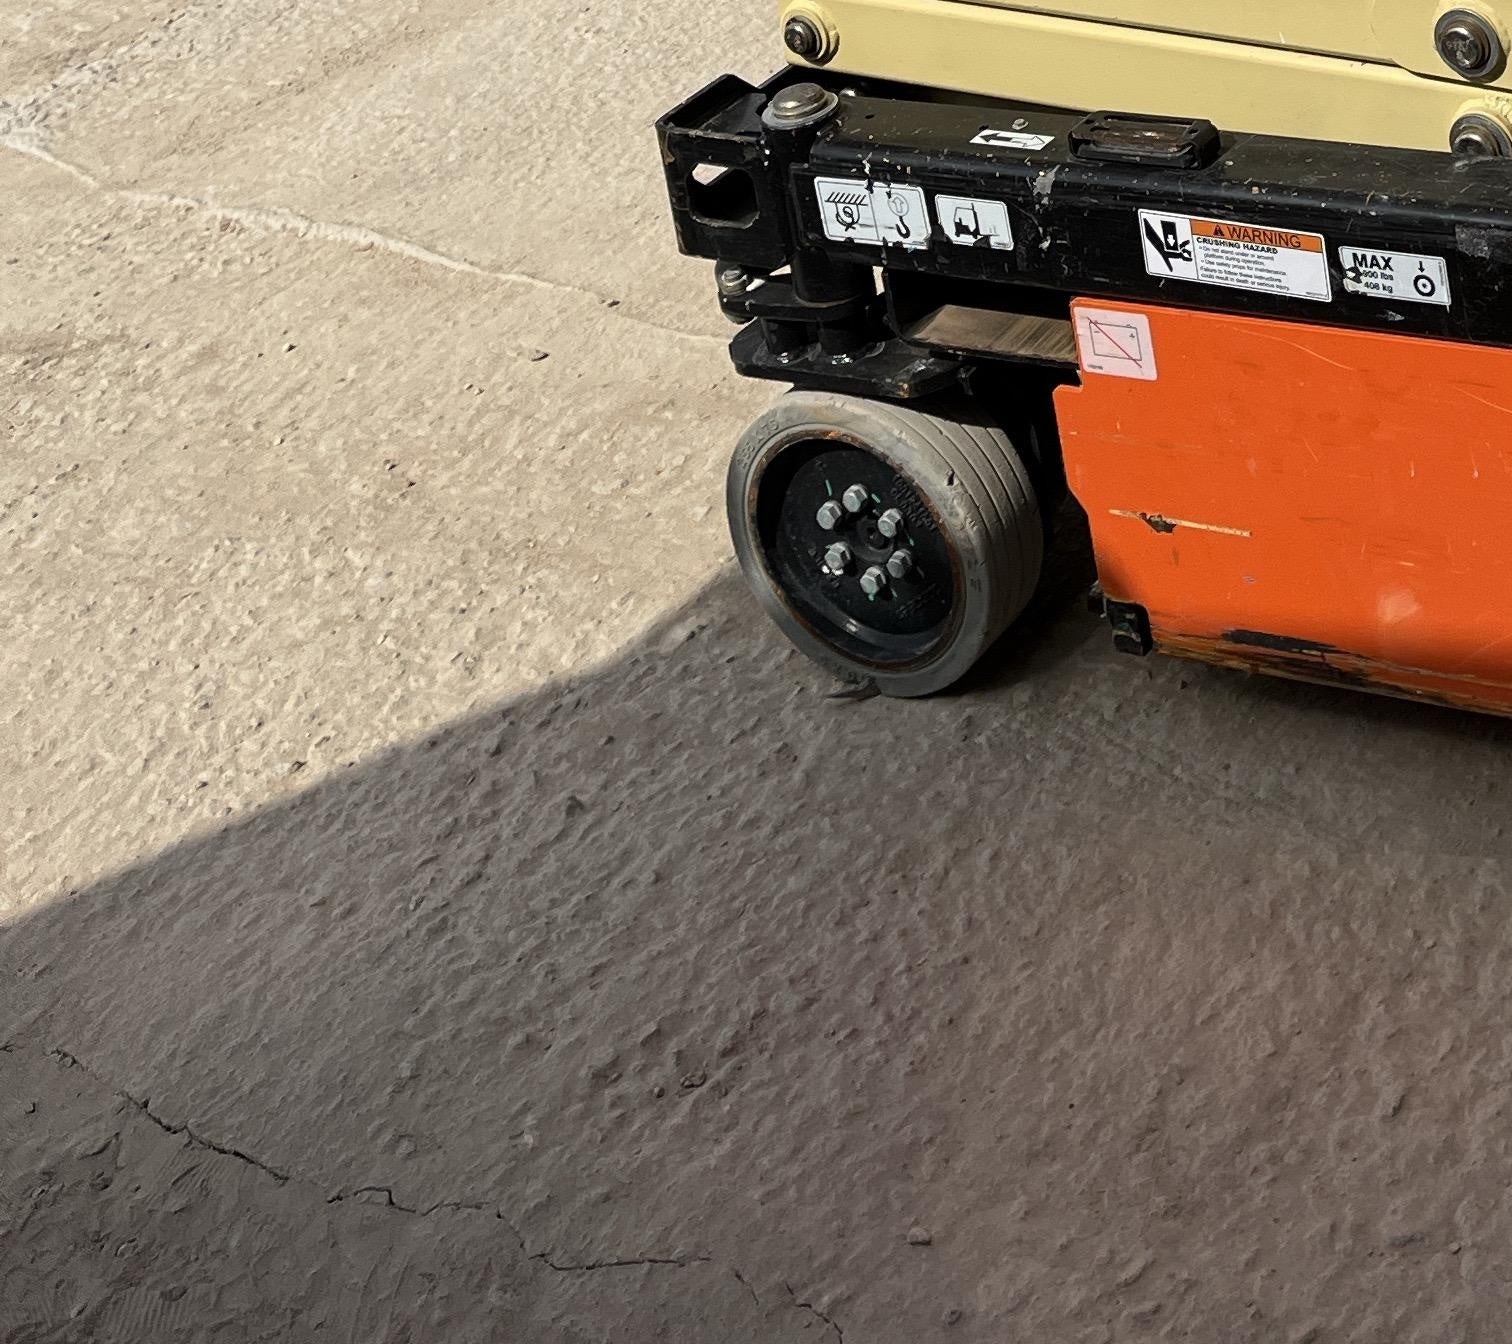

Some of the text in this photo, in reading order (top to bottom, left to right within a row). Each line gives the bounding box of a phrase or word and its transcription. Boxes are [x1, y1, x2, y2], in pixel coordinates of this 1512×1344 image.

[1197, 237, 1278, 255] CRUSHING HAZARD
[1227, 226, 1301, 248] WARNING
[1352, 253, 1394, 271] MAX
[1380, 272, 1394, 281] lbs
[1364, 282, 1393, 294] 408 kg
